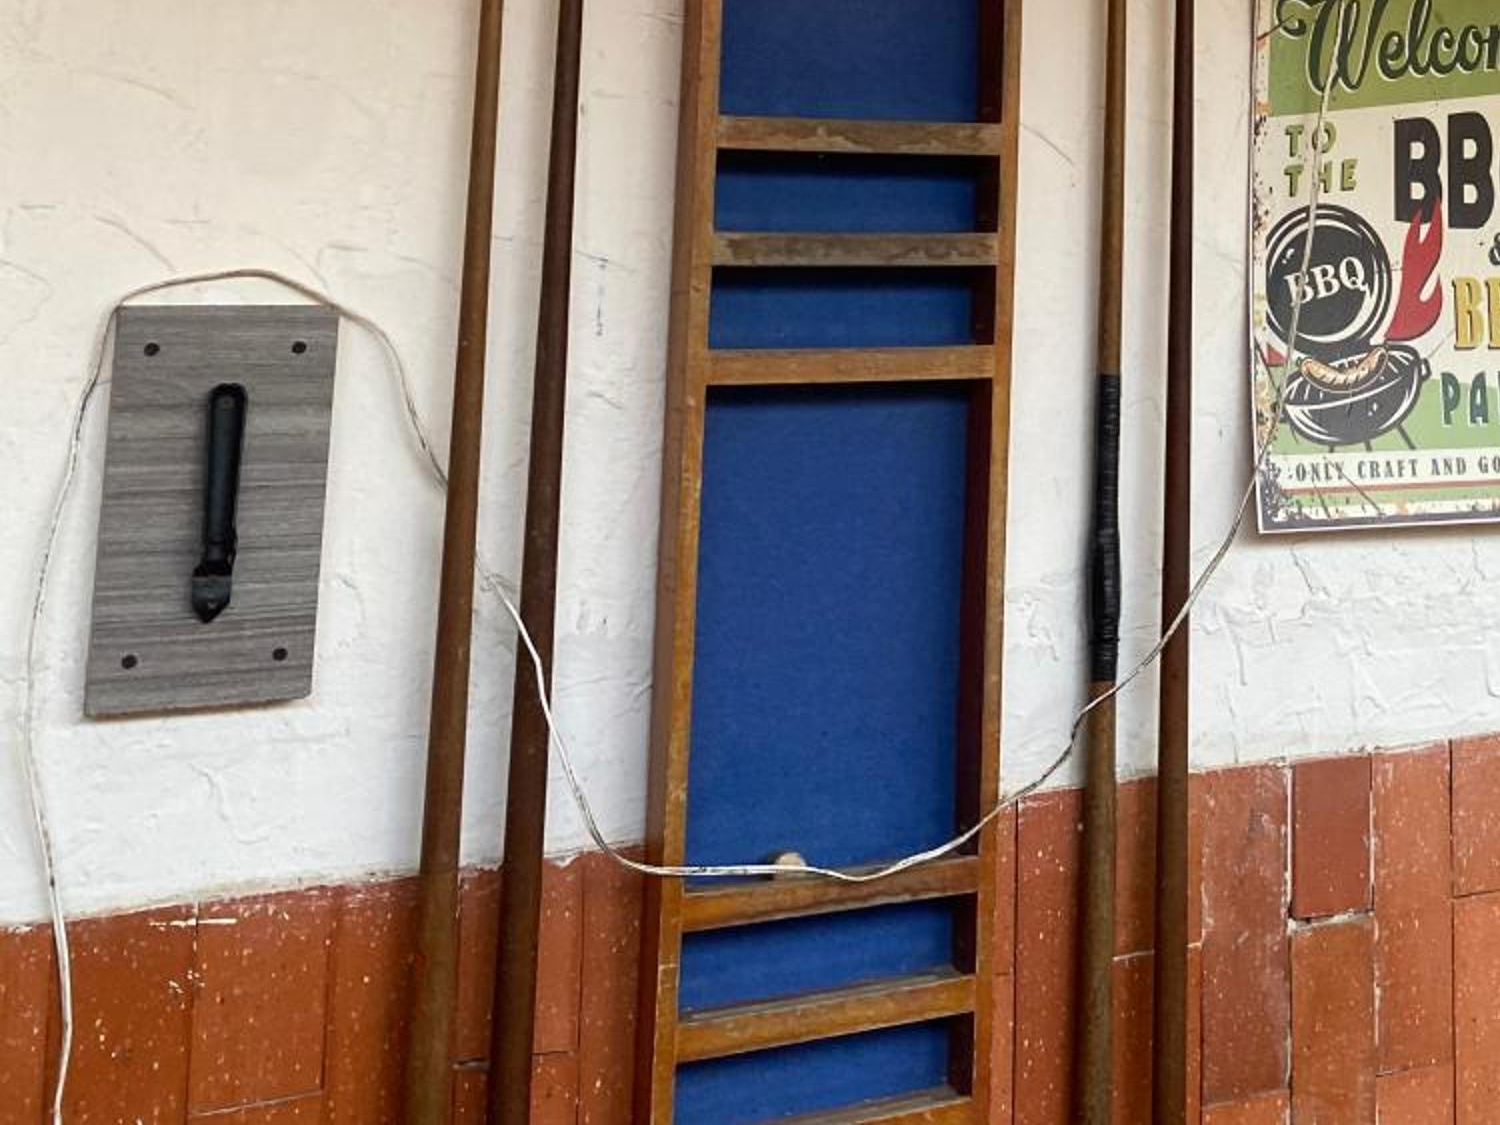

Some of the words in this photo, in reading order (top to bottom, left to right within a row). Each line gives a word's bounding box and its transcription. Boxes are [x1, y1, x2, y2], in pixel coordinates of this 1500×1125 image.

[1285, 121, 1337, 157] TO
[1283, 158, 1358, 198] THE
[1284, 256, 1371, 307] BBQ
[1295, 456, 1344, 483] ONLY
[1358, 458, 1418, 478] CRAFT
[1431, 457, 1466, 477] AND
